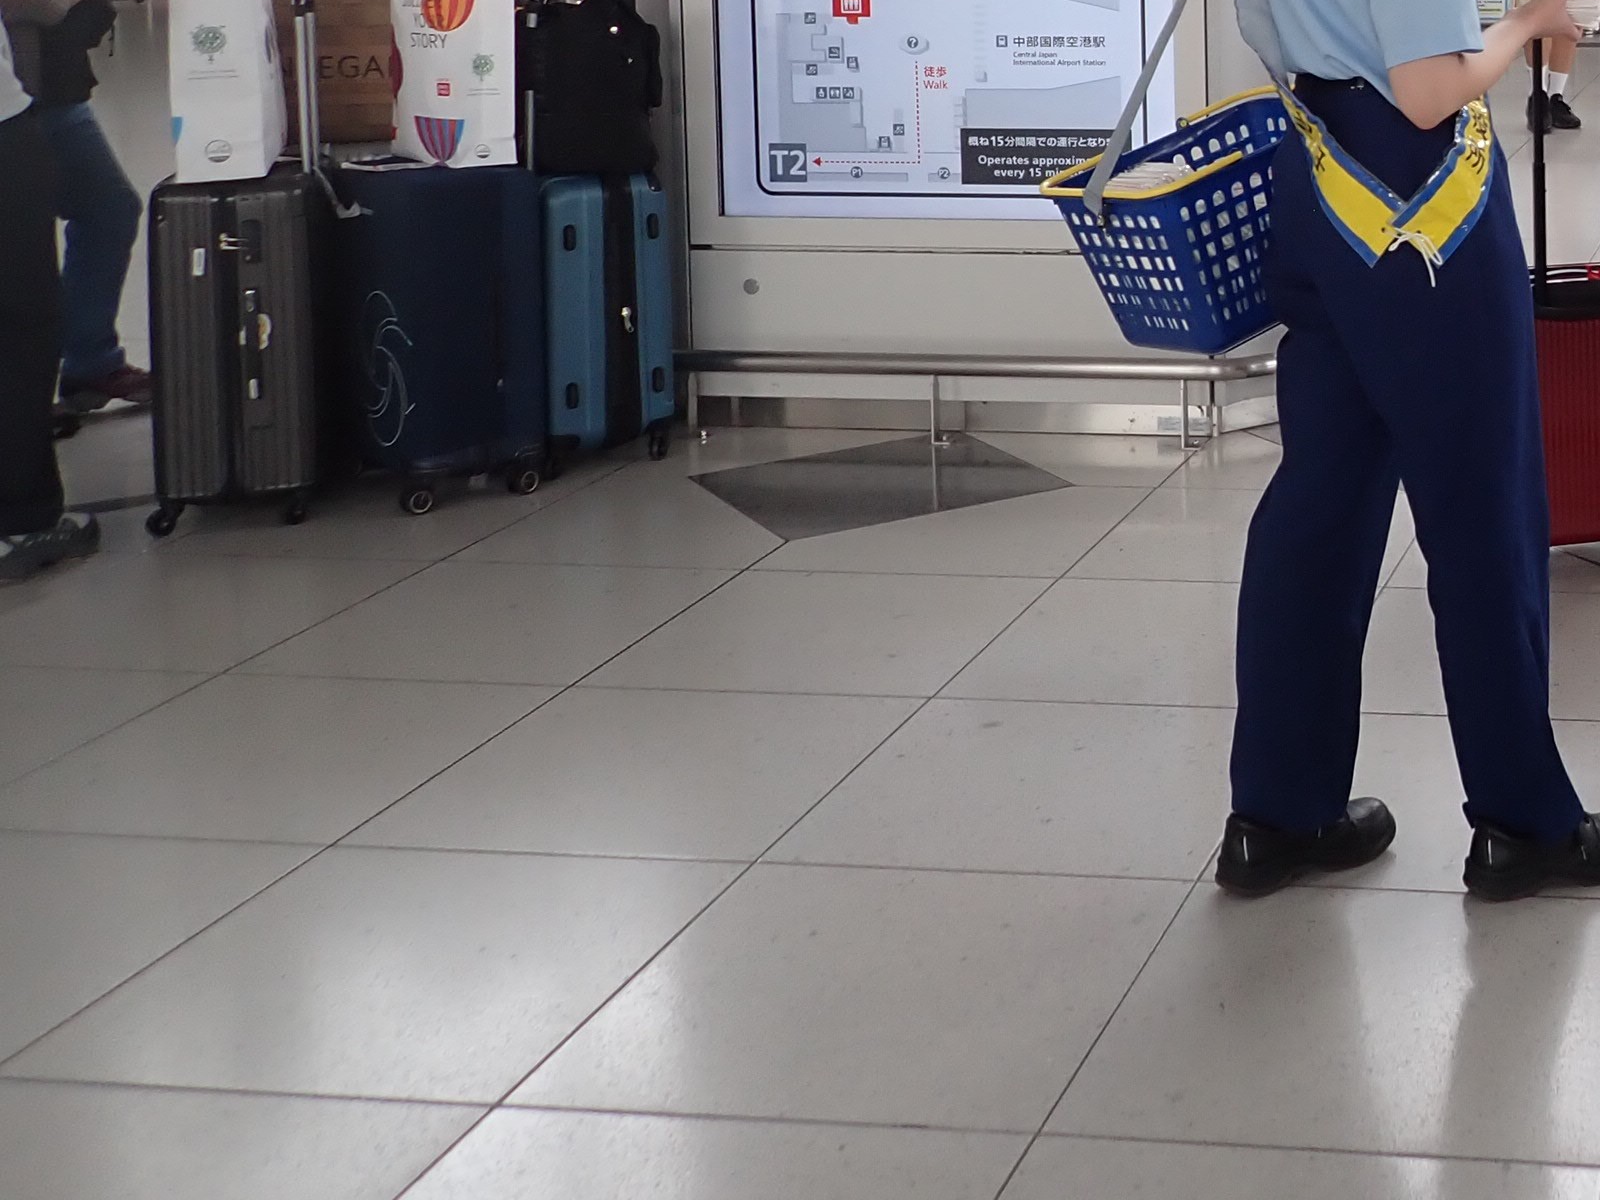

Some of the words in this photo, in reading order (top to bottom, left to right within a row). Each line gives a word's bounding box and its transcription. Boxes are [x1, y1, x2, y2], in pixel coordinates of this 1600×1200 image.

[410, 32, 447, 49] STORY
[1013, 35, 1106, 48] 中部国際空港駅
[923, 66, 947, 78] 徒歩
[923, 80, 948, 90] Walk
[968, 136, 1112, 148] 概ね15分間隔での運行となり
[770, 150, 806, 175] T2
[978, 155, 1028, 169] Operates
[1032, 155, 1089, 169] approxim
[994, 167, 1024, 181] every
[1029, 167, 1043, 179] 15
